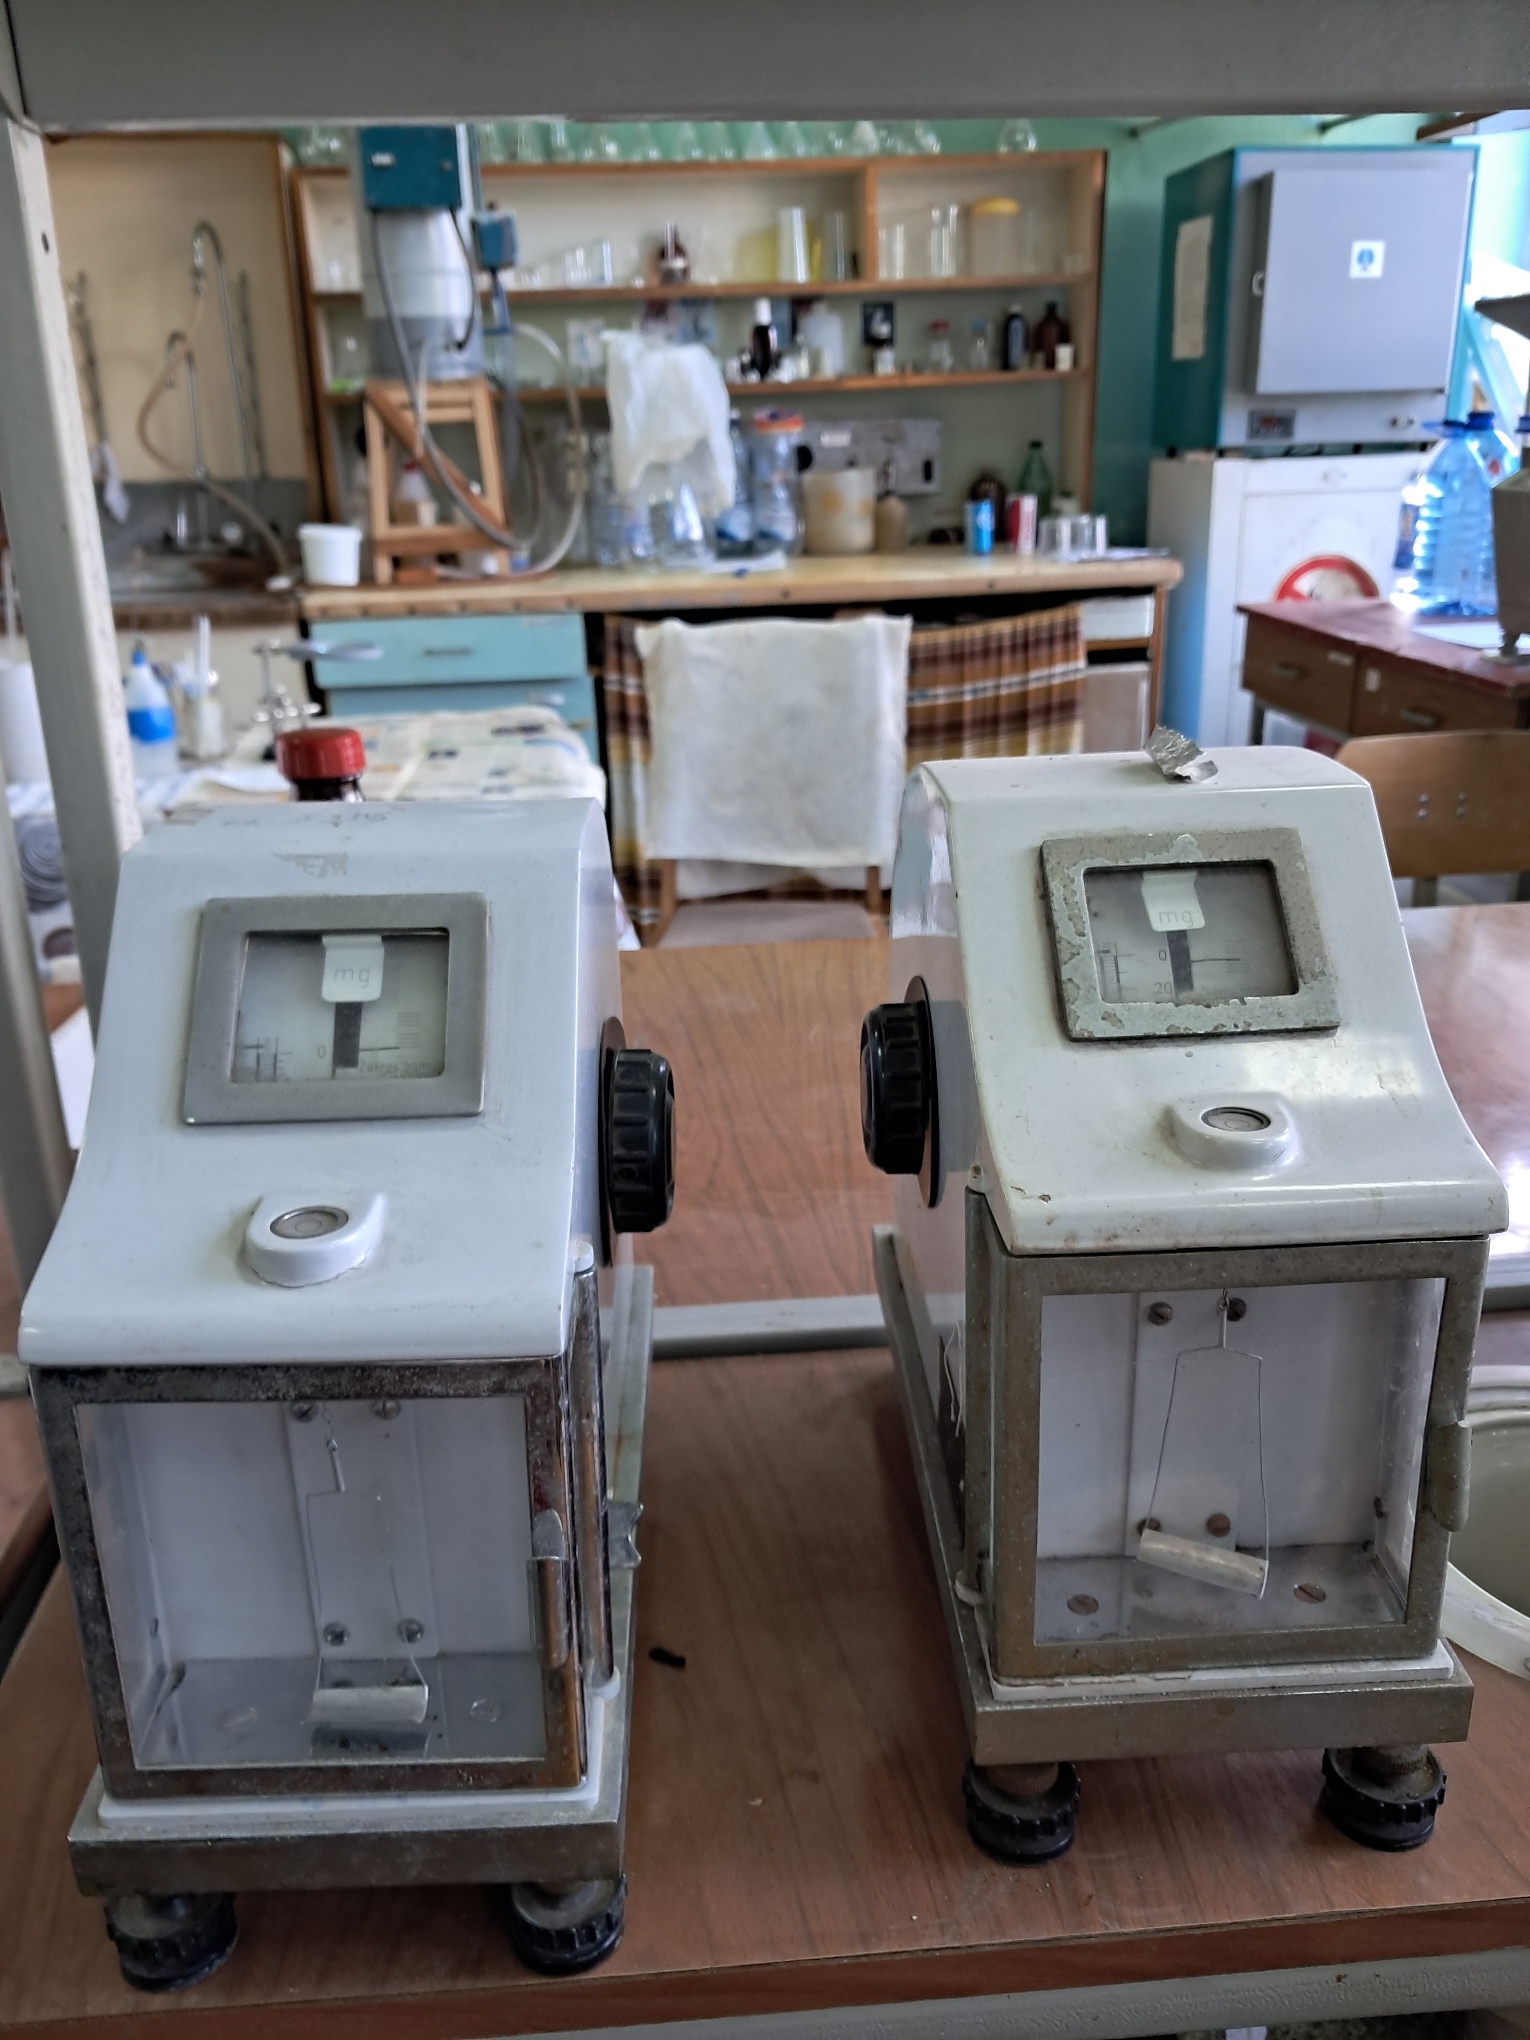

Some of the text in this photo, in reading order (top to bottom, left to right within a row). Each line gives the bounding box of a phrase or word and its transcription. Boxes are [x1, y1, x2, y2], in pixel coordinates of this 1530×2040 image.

[1158, 909, 1194, 928] mg
[1158, 949, 1167, 961] 0
[334, 967, 371, 988] mg
[1154, 982, 1173, 995] 20
[317, 1045, 327, 1059] 0
